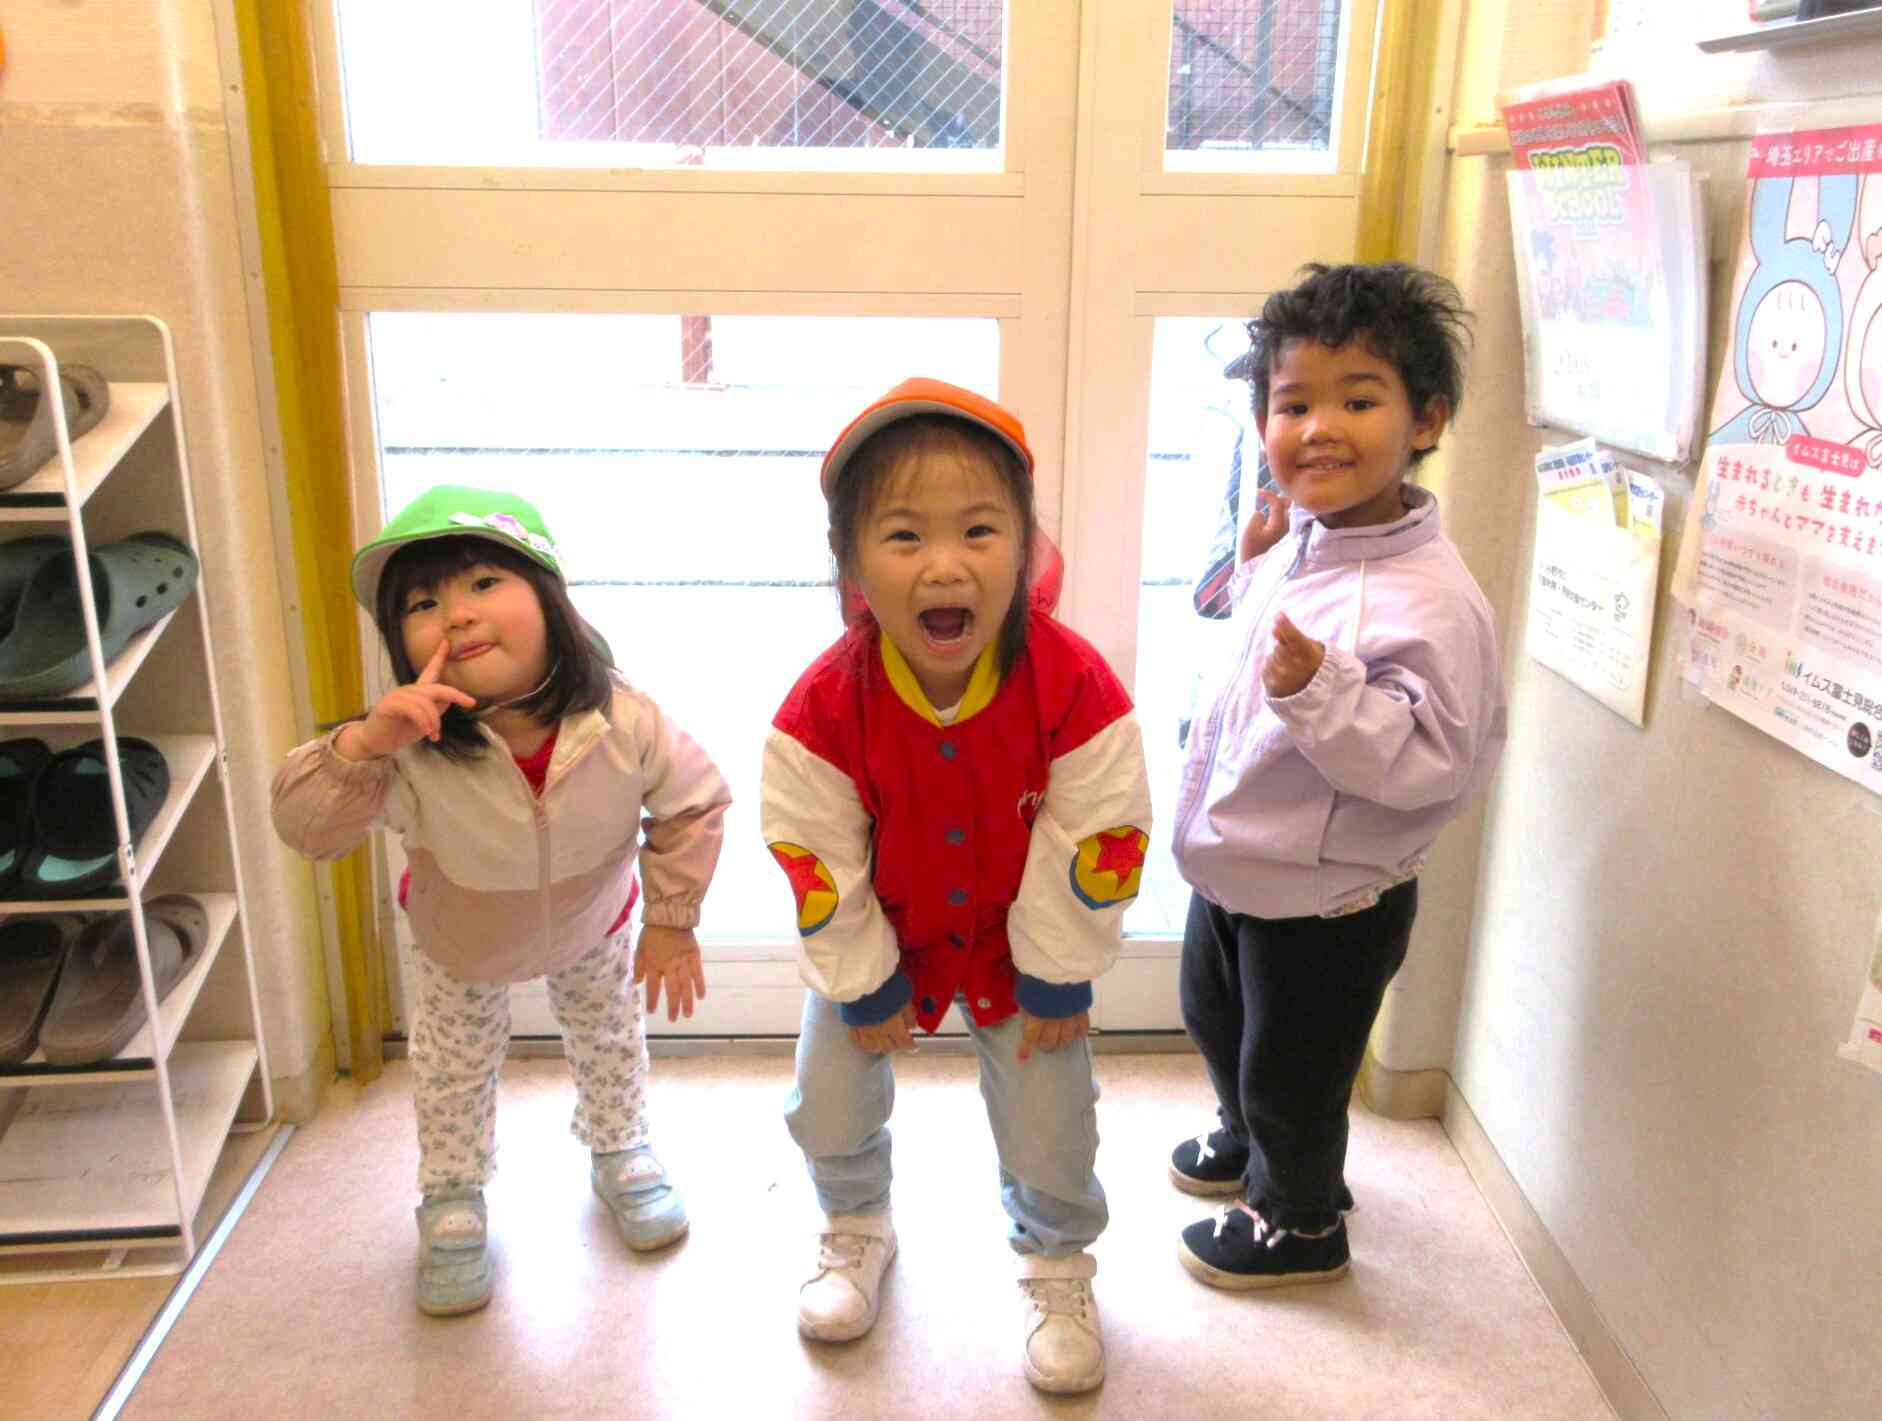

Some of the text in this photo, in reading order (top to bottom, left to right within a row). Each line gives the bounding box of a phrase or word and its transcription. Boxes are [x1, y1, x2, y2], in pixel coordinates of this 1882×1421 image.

[1765, 137, 1882, 168] 埼玉エリアでご出産
